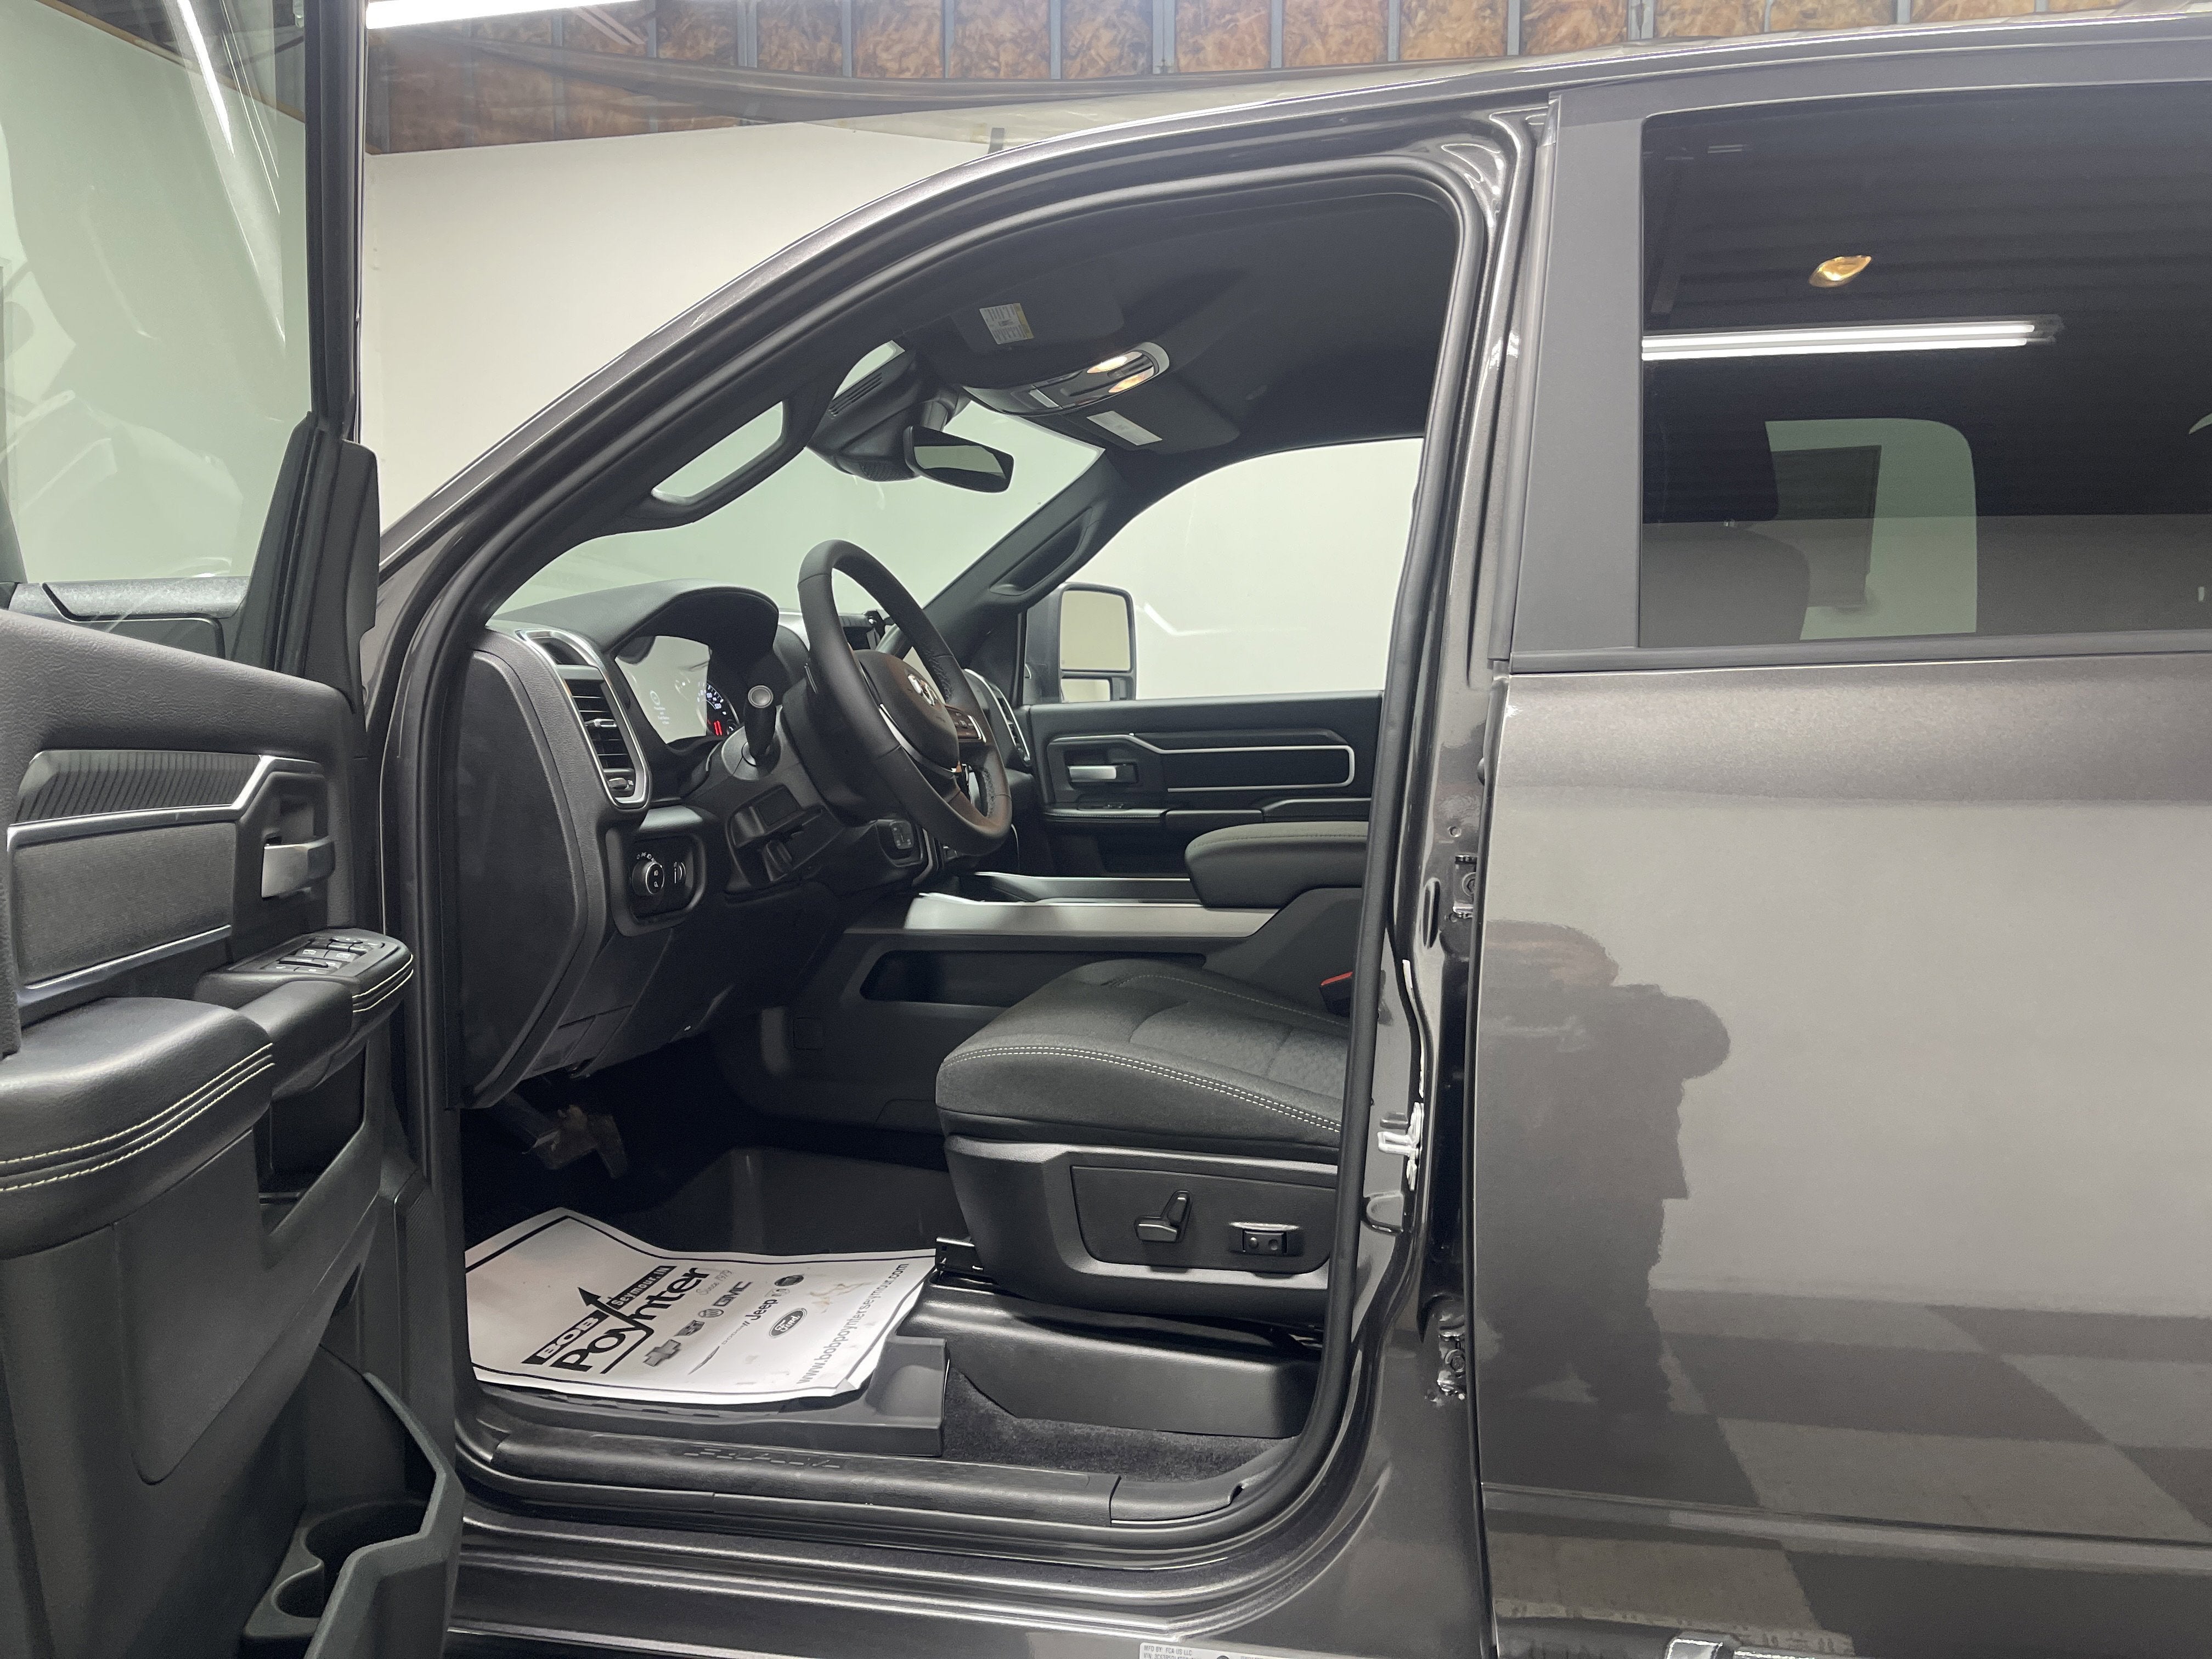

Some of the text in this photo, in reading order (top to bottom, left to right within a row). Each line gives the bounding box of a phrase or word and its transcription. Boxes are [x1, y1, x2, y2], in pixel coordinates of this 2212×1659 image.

[653, 1267, 670, 1276] IN
[713, 1281, 753, 1306] GMC
[549, 1267, 710, 1374] Poynter
[745, 1299, 778, 1321] Jeep
[775, 1315, 800, 1332] Ford
[797, 1263, 909, 1384] www.bobpoynterseymour.com
[536, 1317, 600, 1358] BOB
